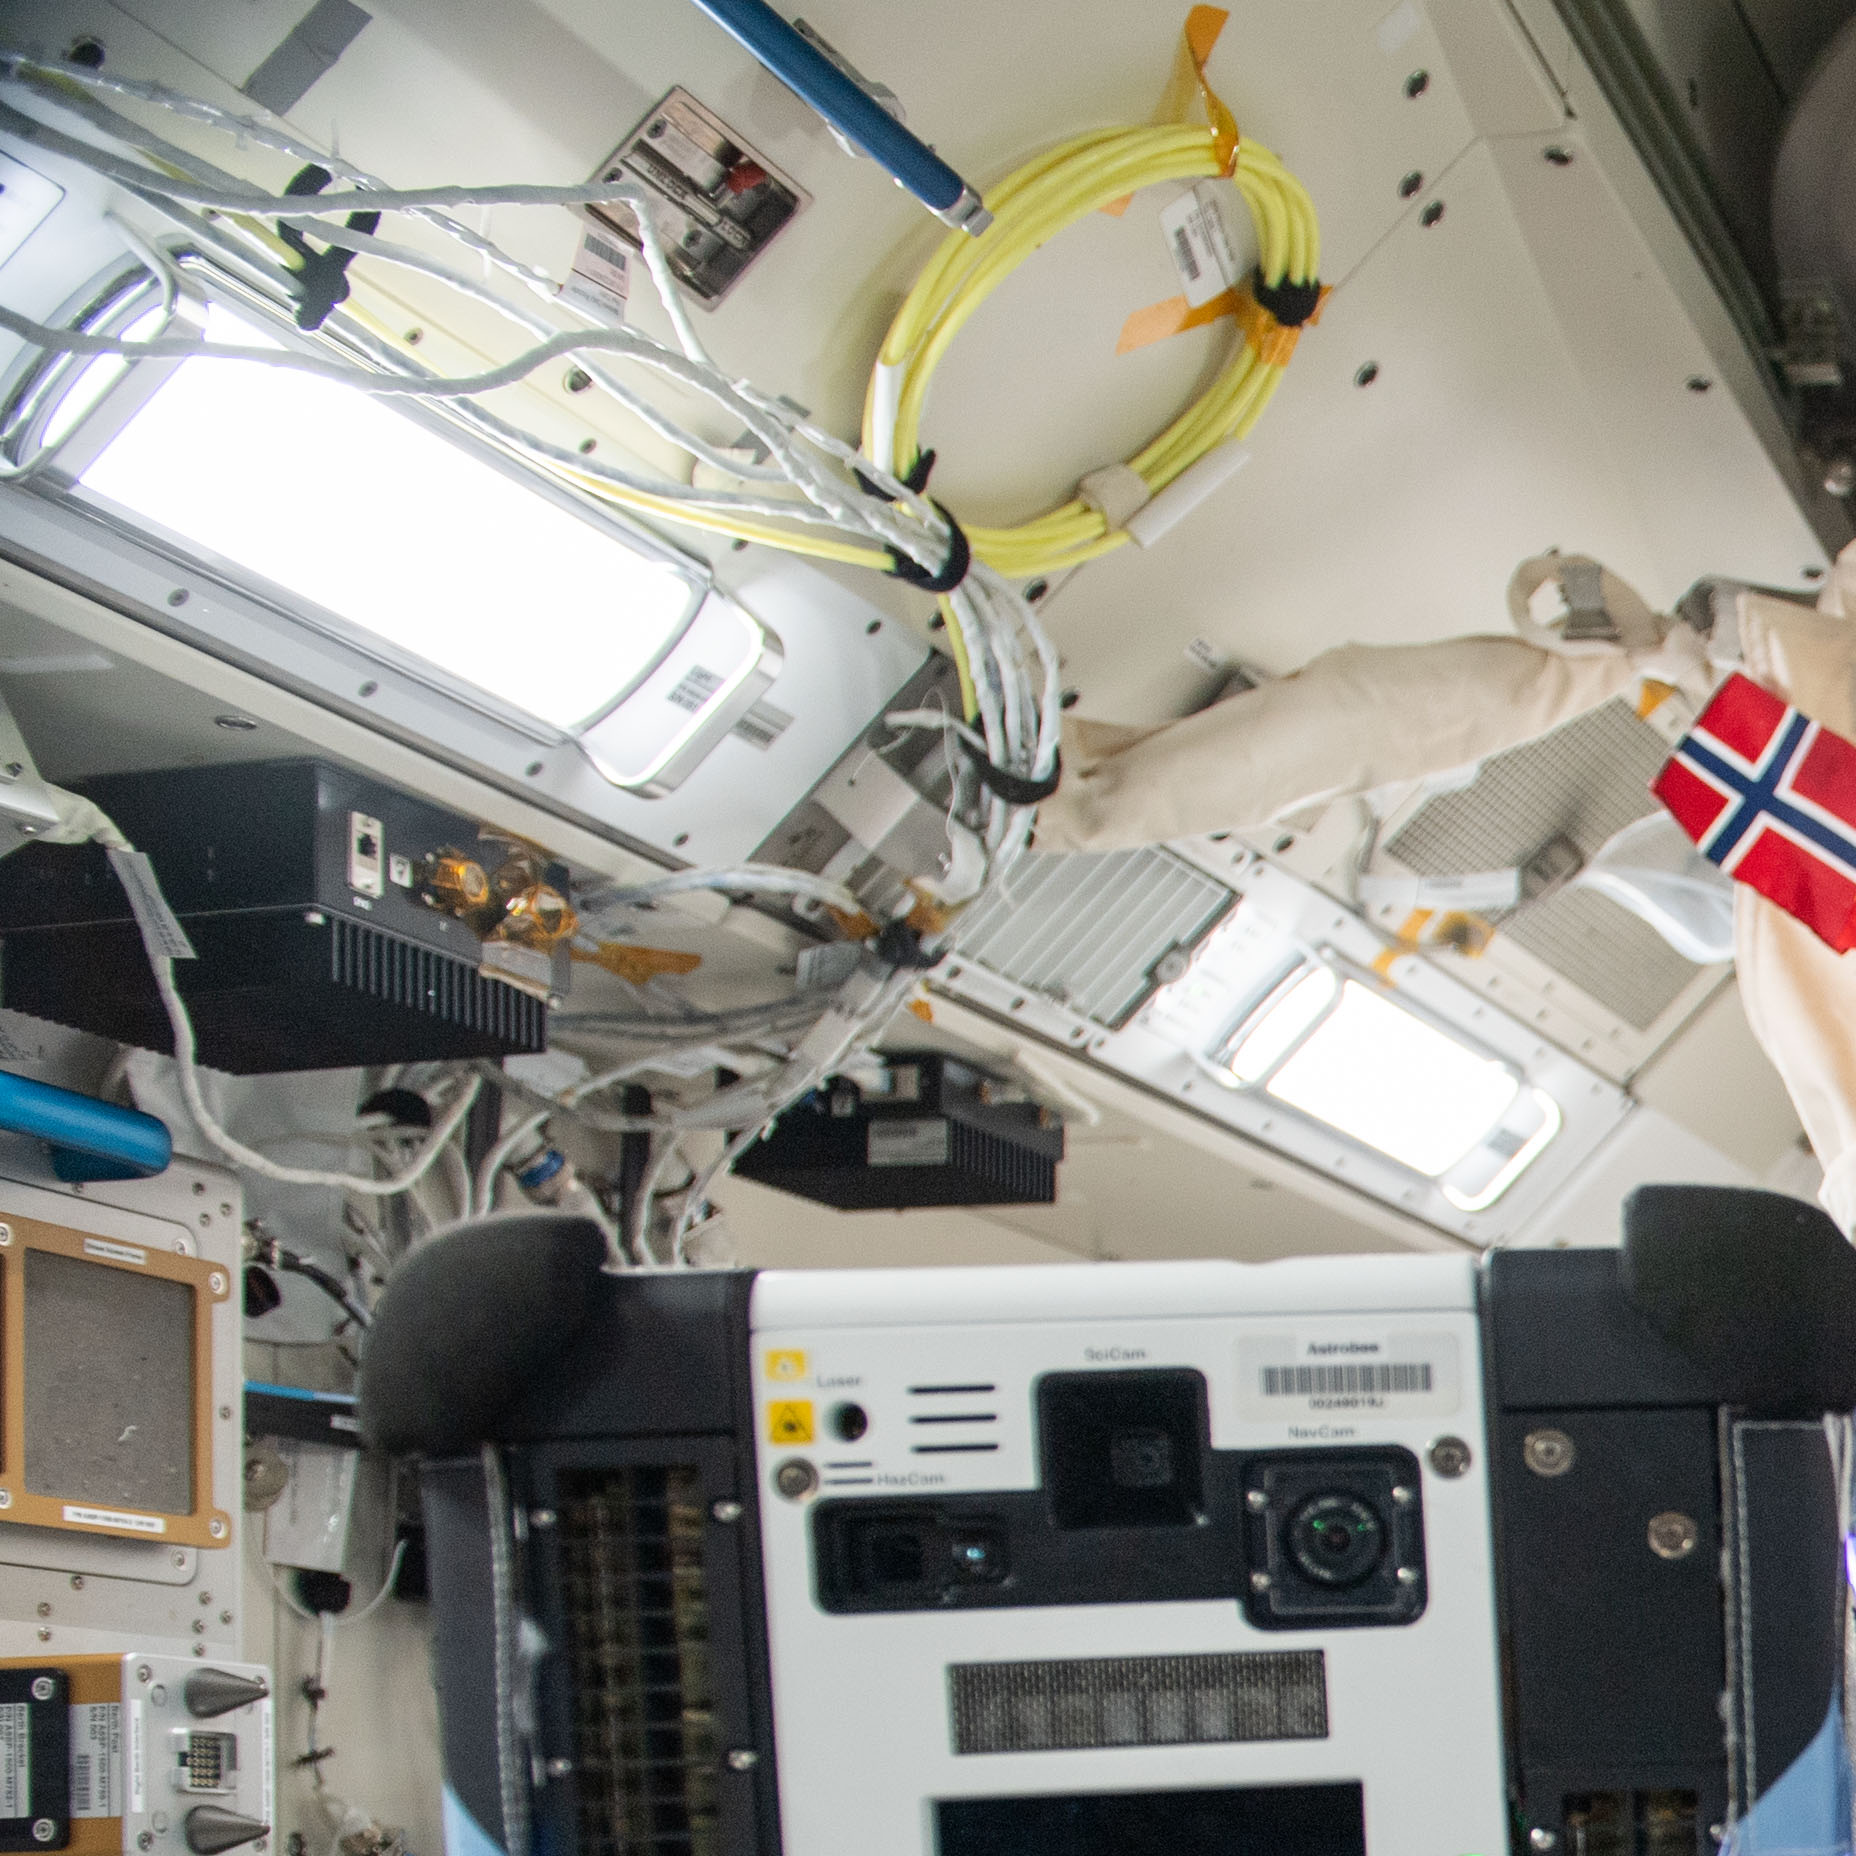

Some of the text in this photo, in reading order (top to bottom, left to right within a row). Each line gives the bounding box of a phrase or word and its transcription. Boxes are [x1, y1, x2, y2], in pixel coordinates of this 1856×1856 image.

[645, 163, 690, 201] UNLOCK
[721, 220, 750, 247] LOCK
[1083, 1347, 1146, 1362] SciCam
[1306, 1341, 1380, 1356] Astrobee
[816, 1374, 862, 1389] Laser
[1287, 1425, 1355, 1439] NavCam
[875, 1471, 946, 1487] HazCam
